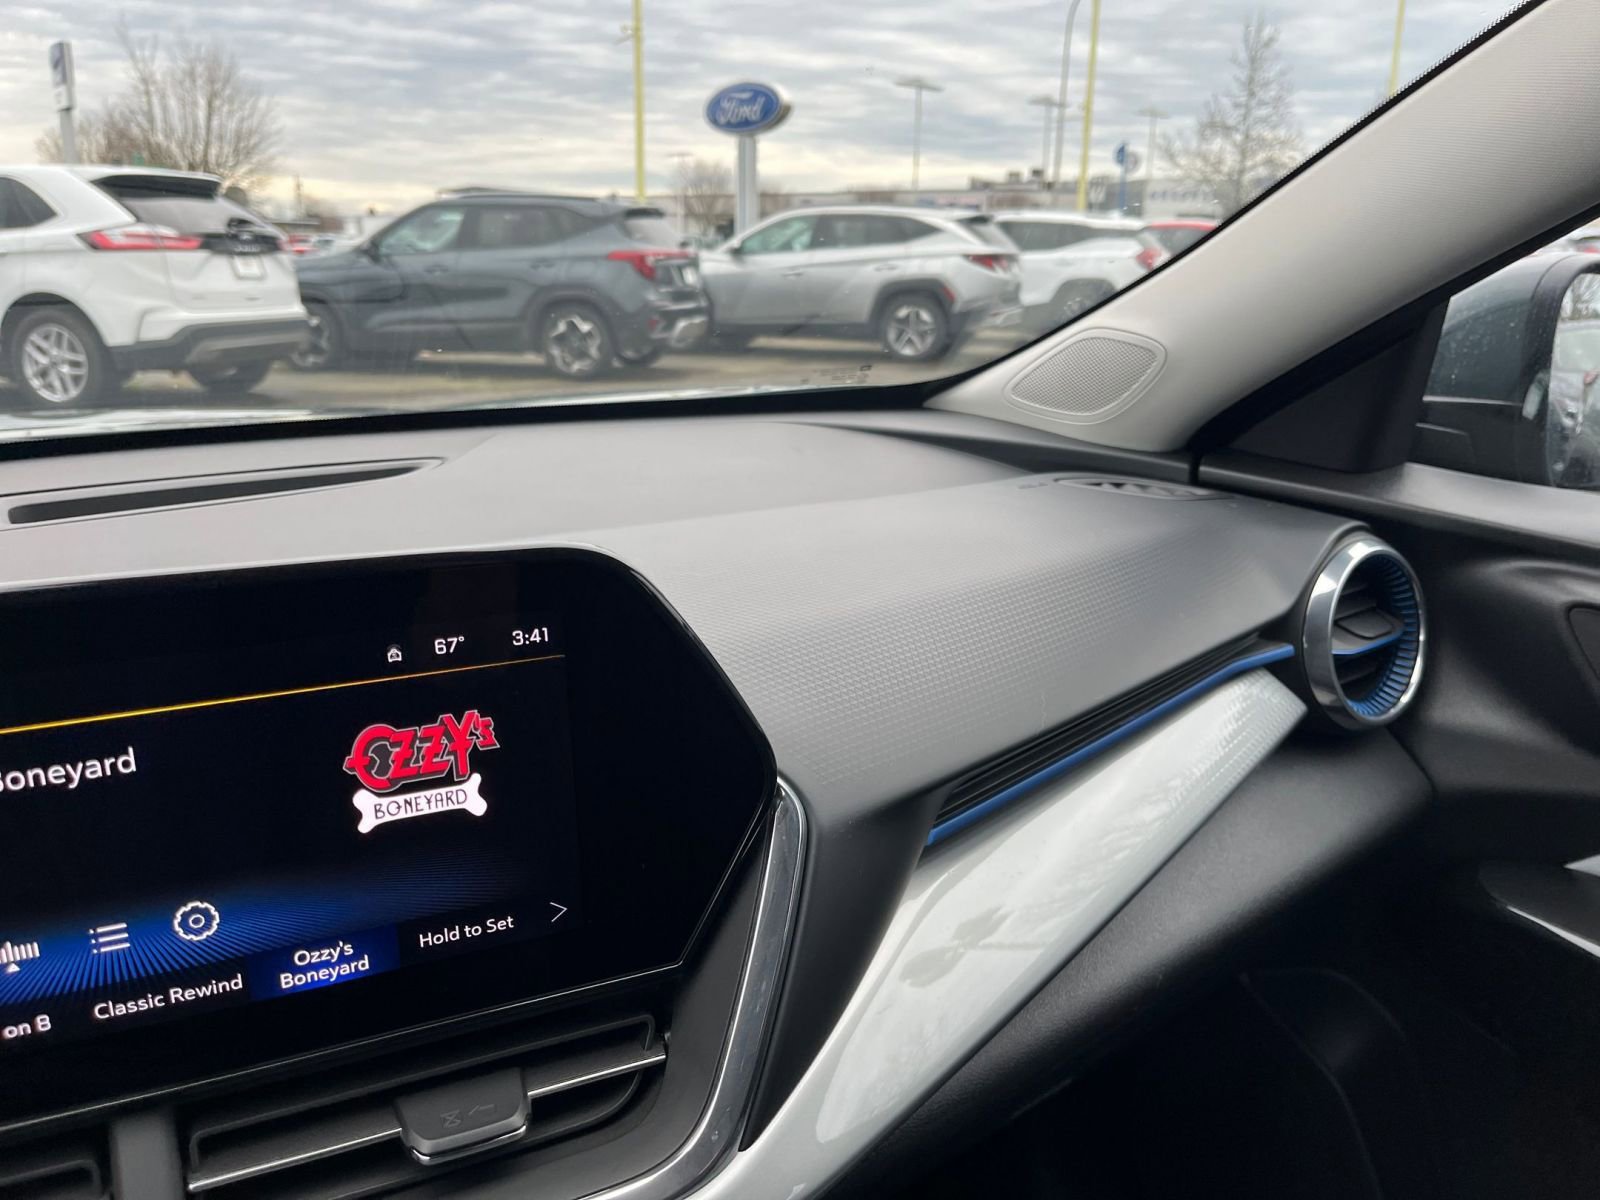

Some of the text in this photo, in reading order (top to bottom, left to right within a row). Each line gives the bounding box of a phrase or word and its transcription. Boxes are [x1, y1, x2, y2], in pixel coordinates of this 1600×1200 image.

[512, 627, 549, 646] 3:41
[373, 788, 468, 820] BONEYARD
[419, 915, 514, 948] Hold to Set
[293, 941, 353, 966] Ozzy's
[279, 954, 370, 989] Boneyard
[94, 973, 243, 1019] Classic Rewind
[3, 1014, 51, 1040] on B
